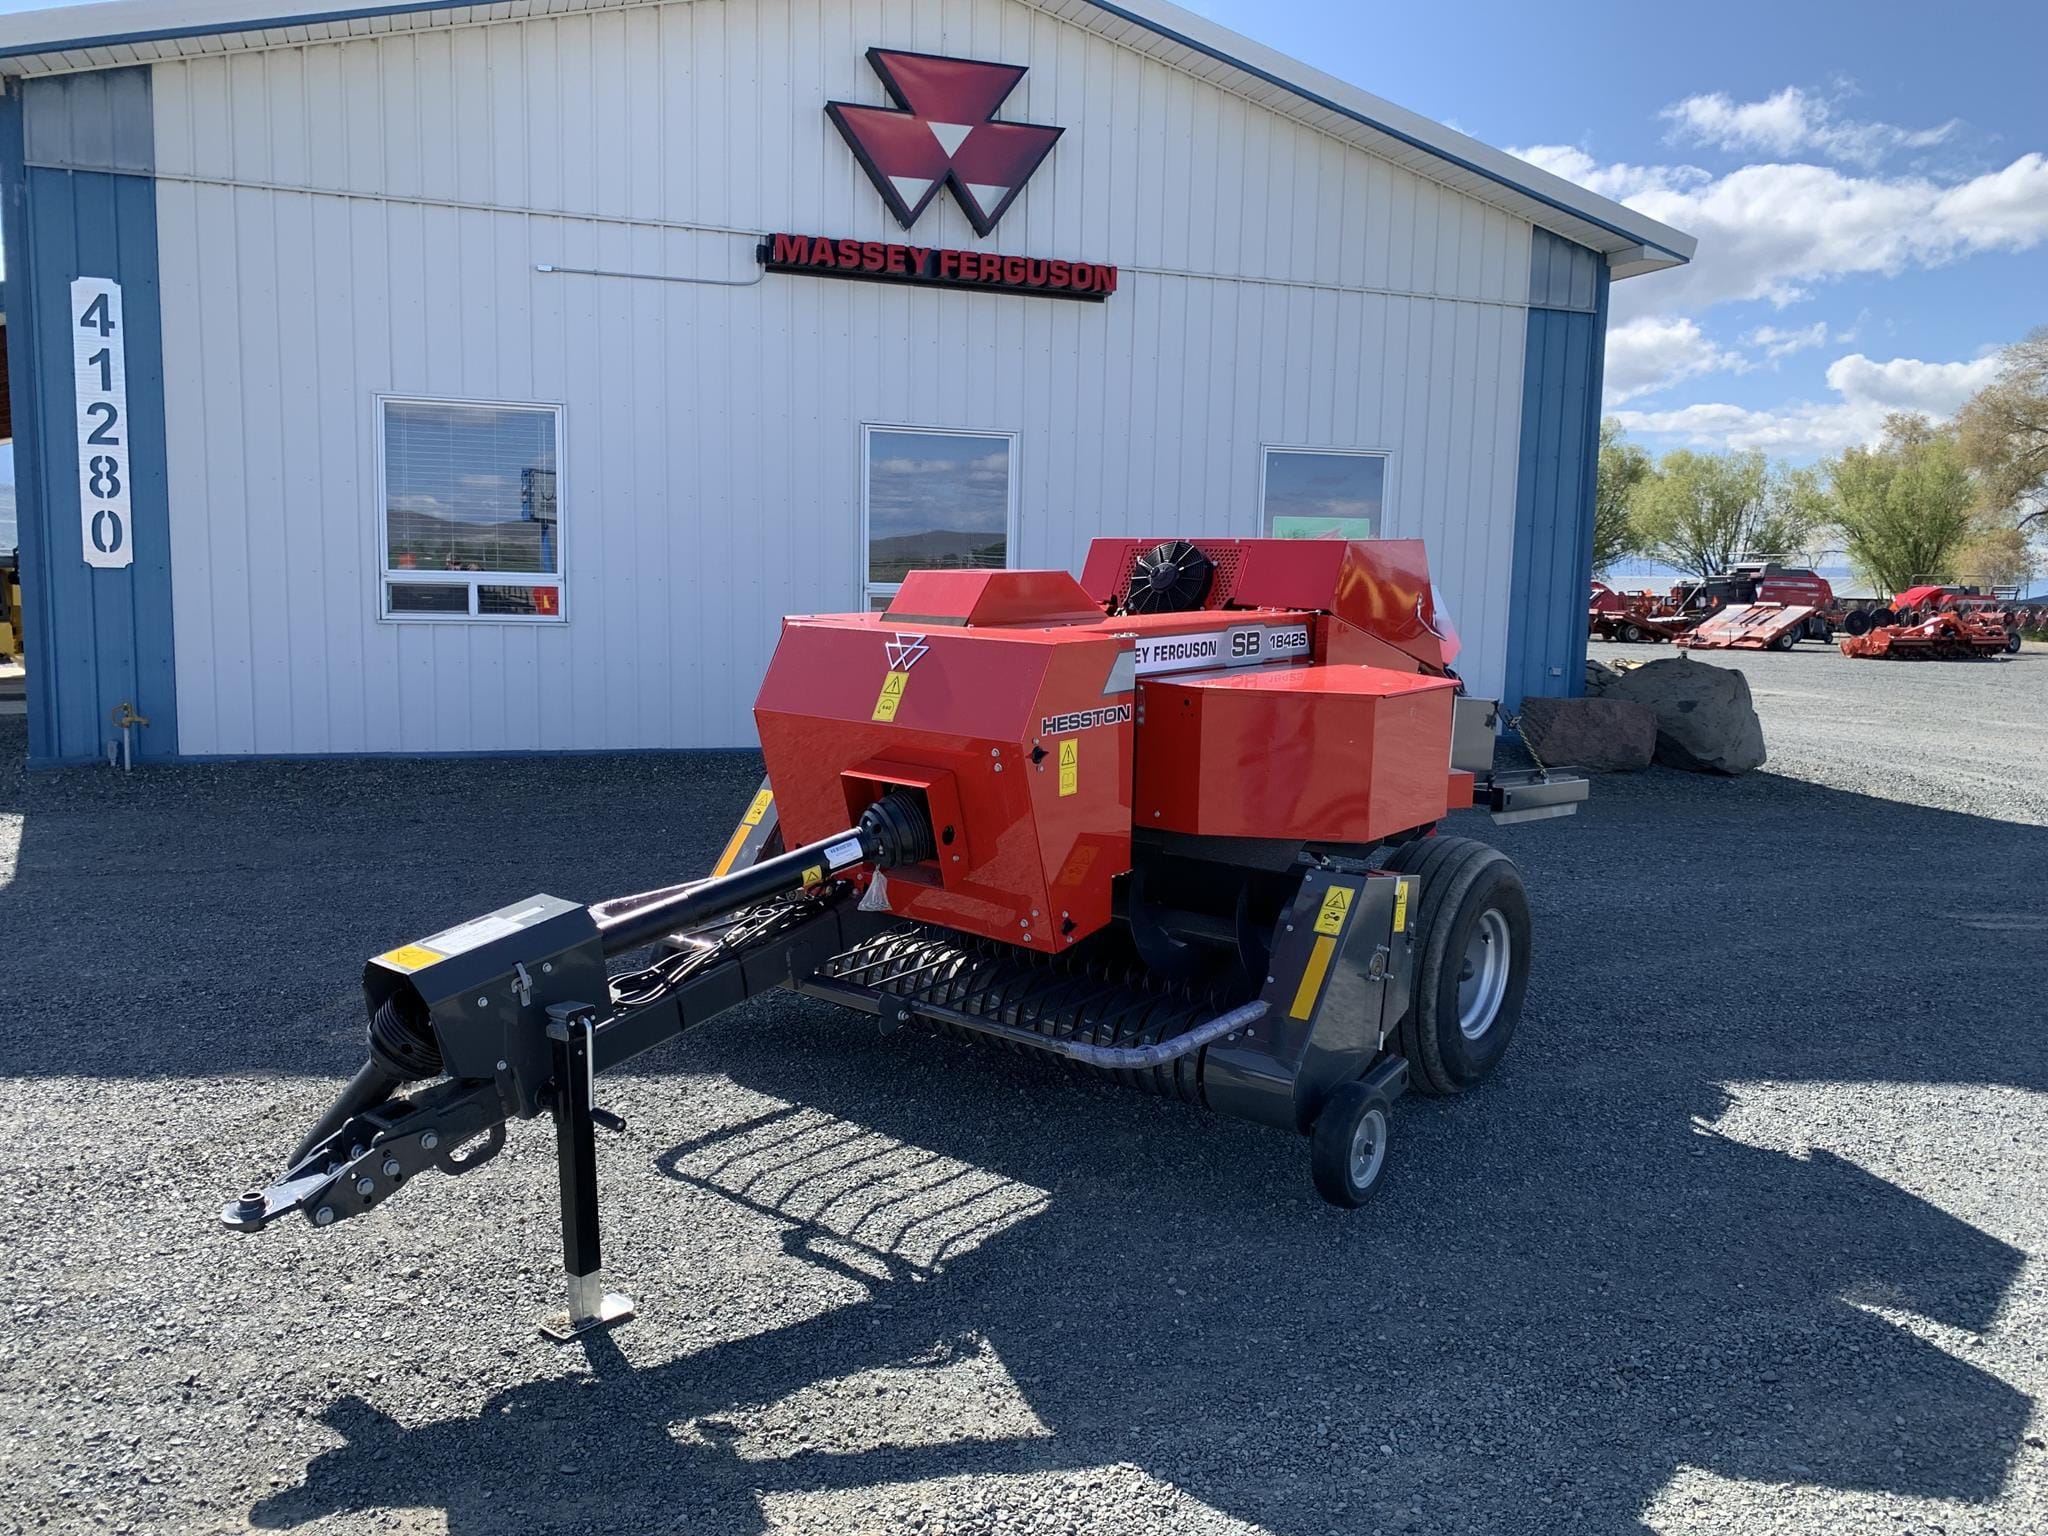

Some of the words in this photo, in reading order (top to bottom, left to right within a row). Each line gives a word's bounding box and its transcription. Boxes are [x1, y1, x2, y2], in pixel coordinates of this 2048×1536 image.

[775, 232, 930, 273] MASSEY
[940, 249, 1117, 292] FERGUSON
[80, 292, 123, 554] 41280
[1154, 640, 1217, 662] FERGUSON
[1231, 631, 1261, 657] SB
[1270, 632, 1307, 649] 1842S
[1042, 704, 1132, 736] HESSTON
